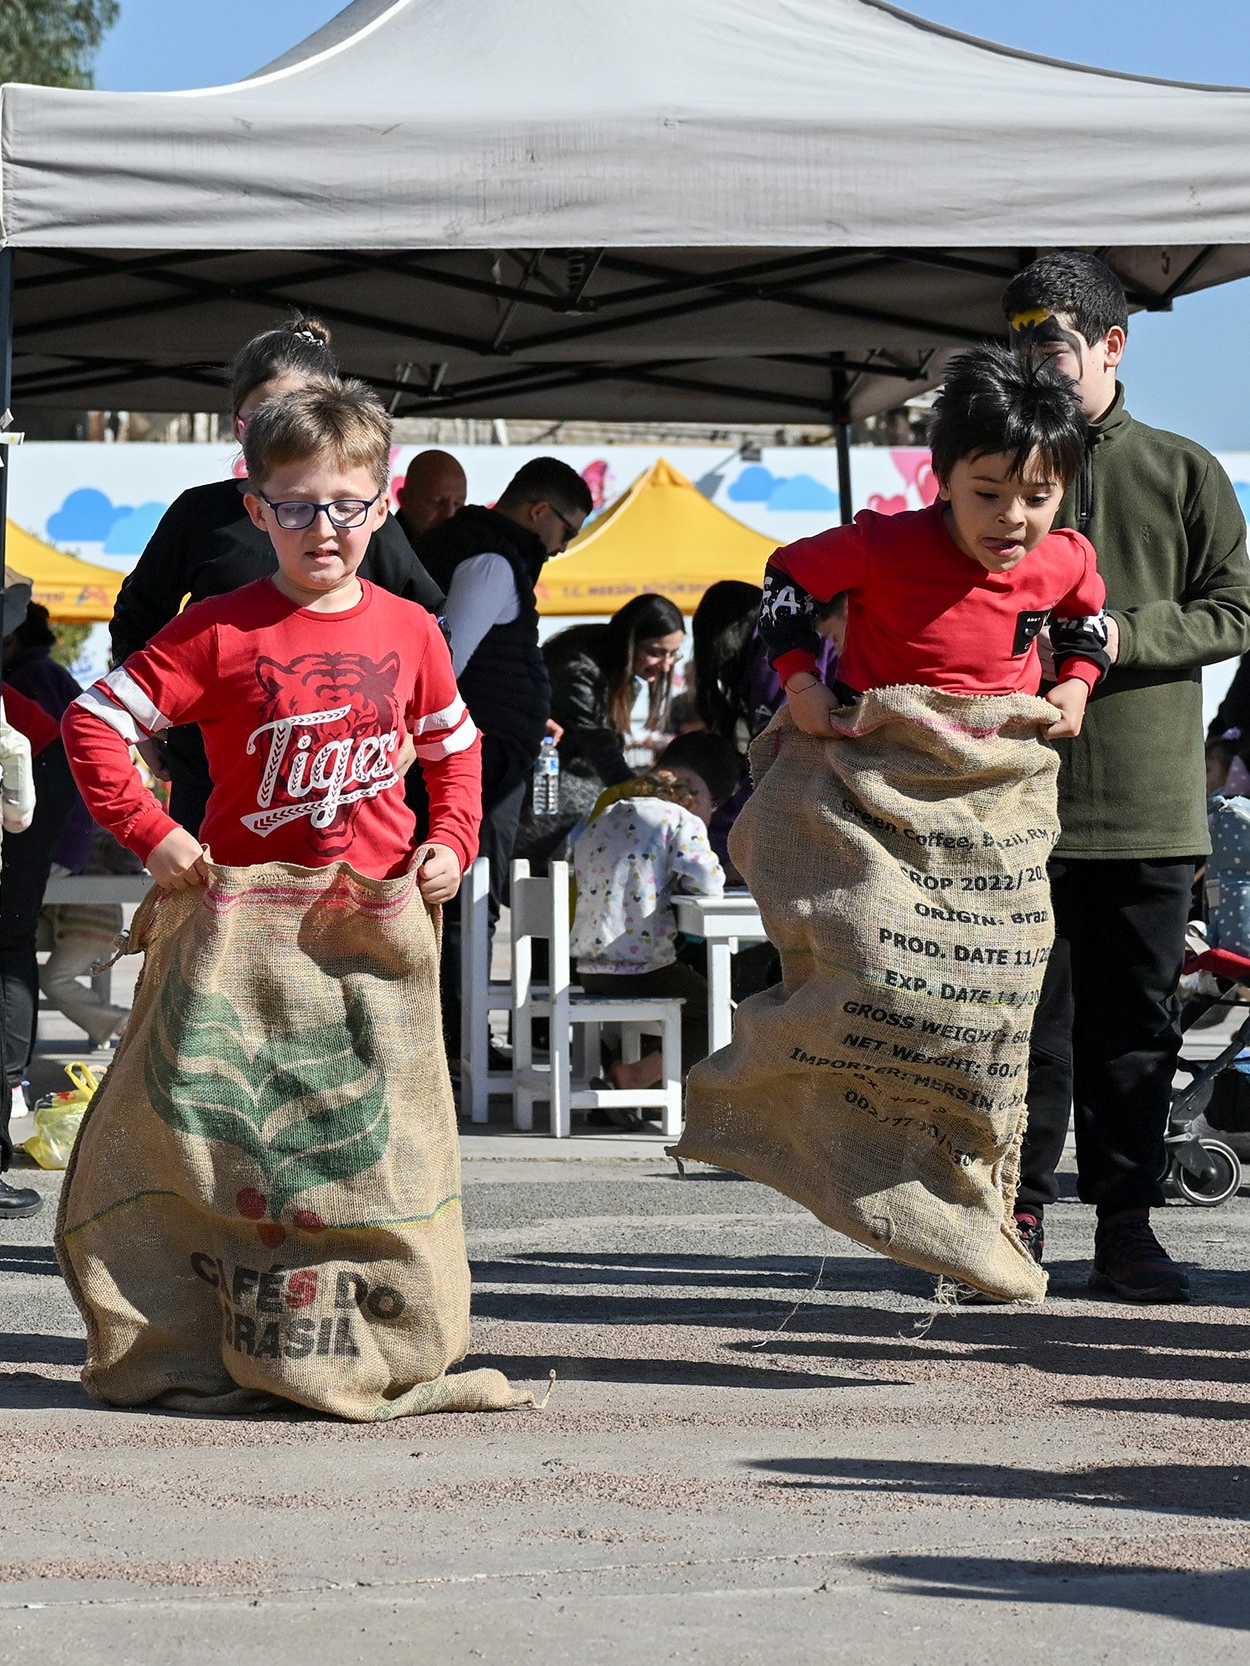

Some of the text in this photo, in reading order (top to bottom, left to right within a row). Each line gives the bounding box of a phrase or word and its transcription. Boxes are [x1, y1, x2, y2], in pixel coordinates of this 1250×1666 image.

[903, 828, 975, 850] coffee,
[915, 902, 1004, 926] ORIGIN:
[879, 928, 946, 959] PROD.
[954, 944, 1008, 965] DATE
[886, 969, 933, 996] EXP.
[940, 983, 991, 1004] DATE
[843, 1001, 917, 1028] GROSS
[842, 1033, 887, 1051] NET
[893, 1043, 981, 1075] WEIGHT:
[335, 1271, 406, 1320] DO
